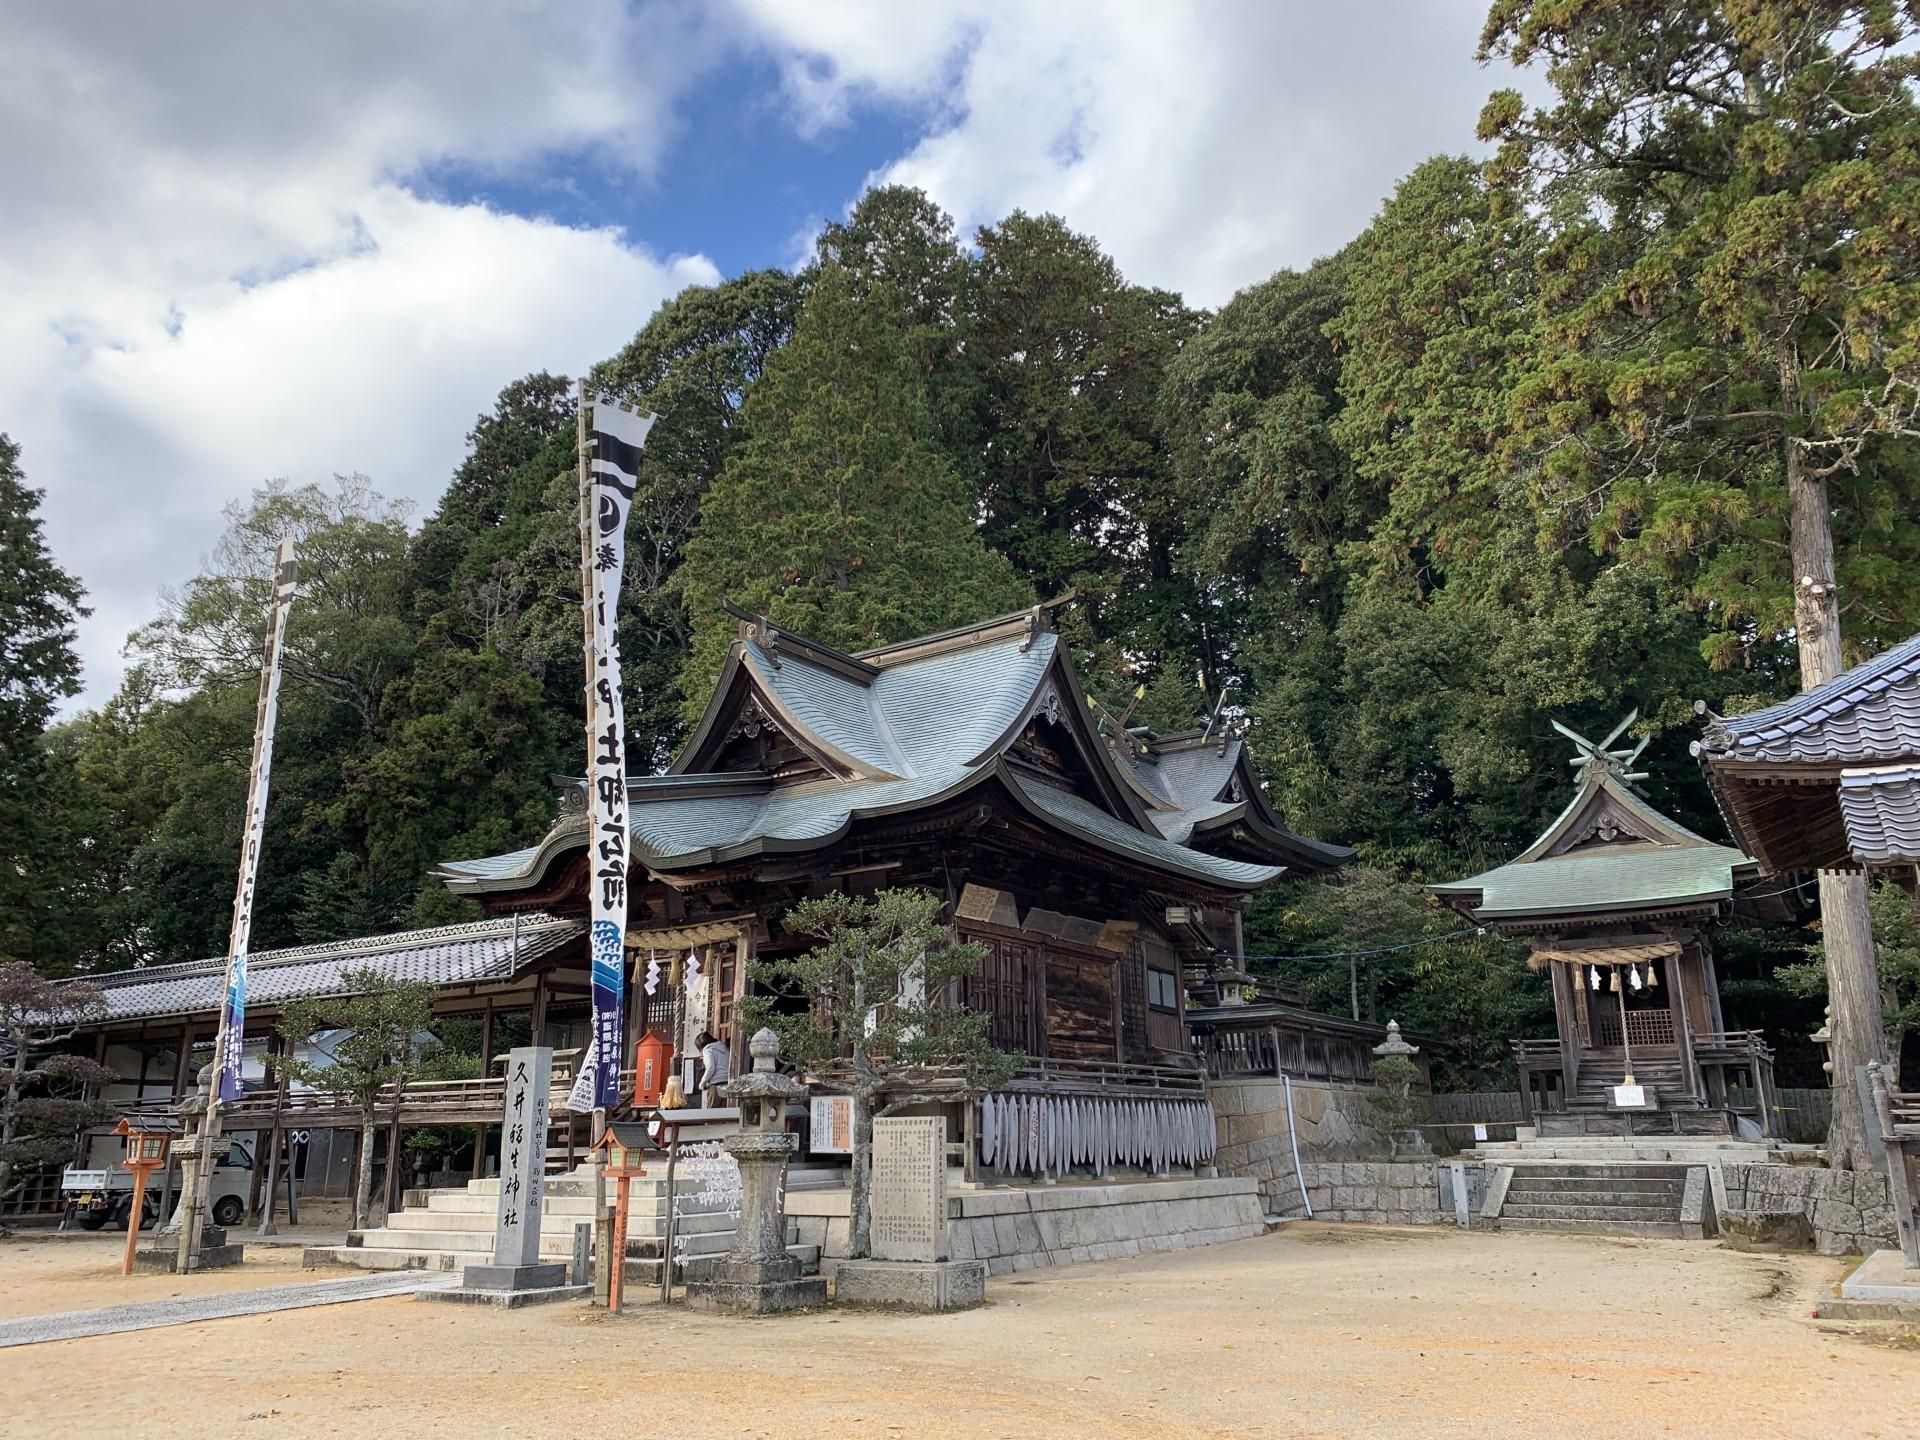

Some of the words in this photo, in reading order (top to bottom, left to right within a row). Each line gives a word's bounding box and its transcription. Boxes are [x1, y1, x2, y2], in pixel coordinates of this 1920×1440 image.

[503, 1060, 529, 1228] 久井稲生神社
